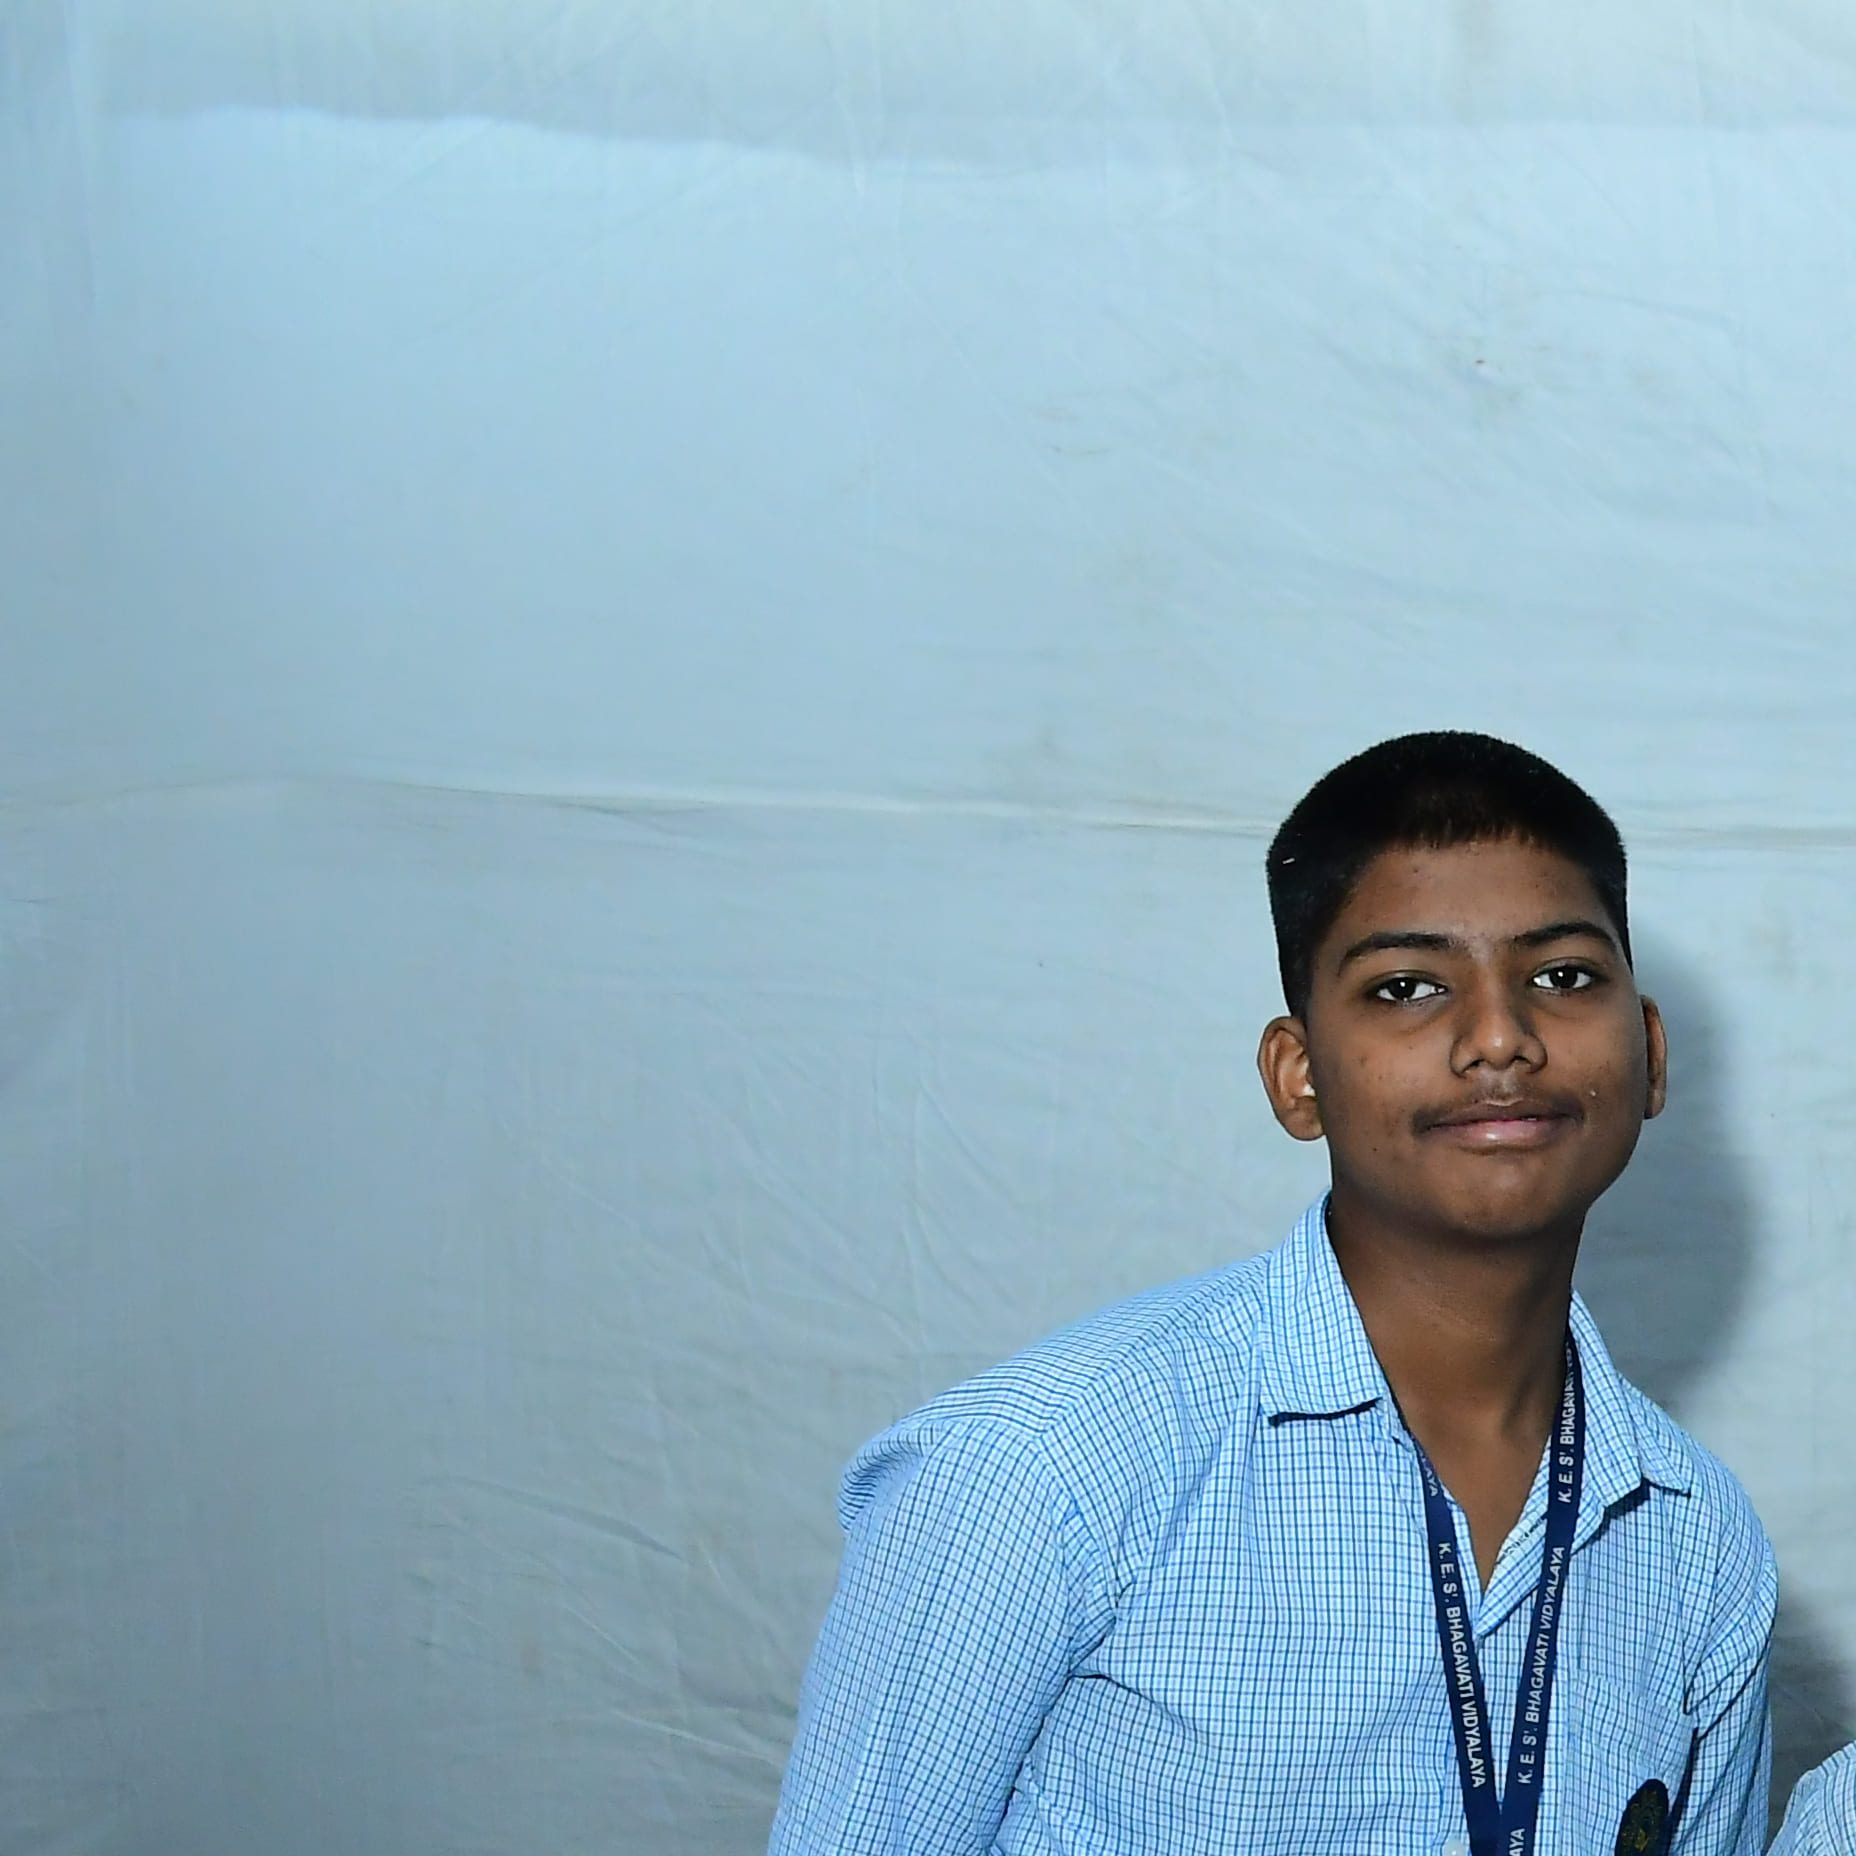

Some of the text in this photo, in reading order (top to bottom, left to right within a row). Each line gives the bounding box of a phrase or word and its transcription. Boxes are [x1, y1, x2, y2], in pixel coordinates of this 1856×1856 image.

[1445, 1605, 1475, 1698] BHAGAVATI
[1524, 1545, 1566, 1725] BHAGAVATI VIDYALAYA
[1459, 1700, 1488, 1790] VIDYALAYA
